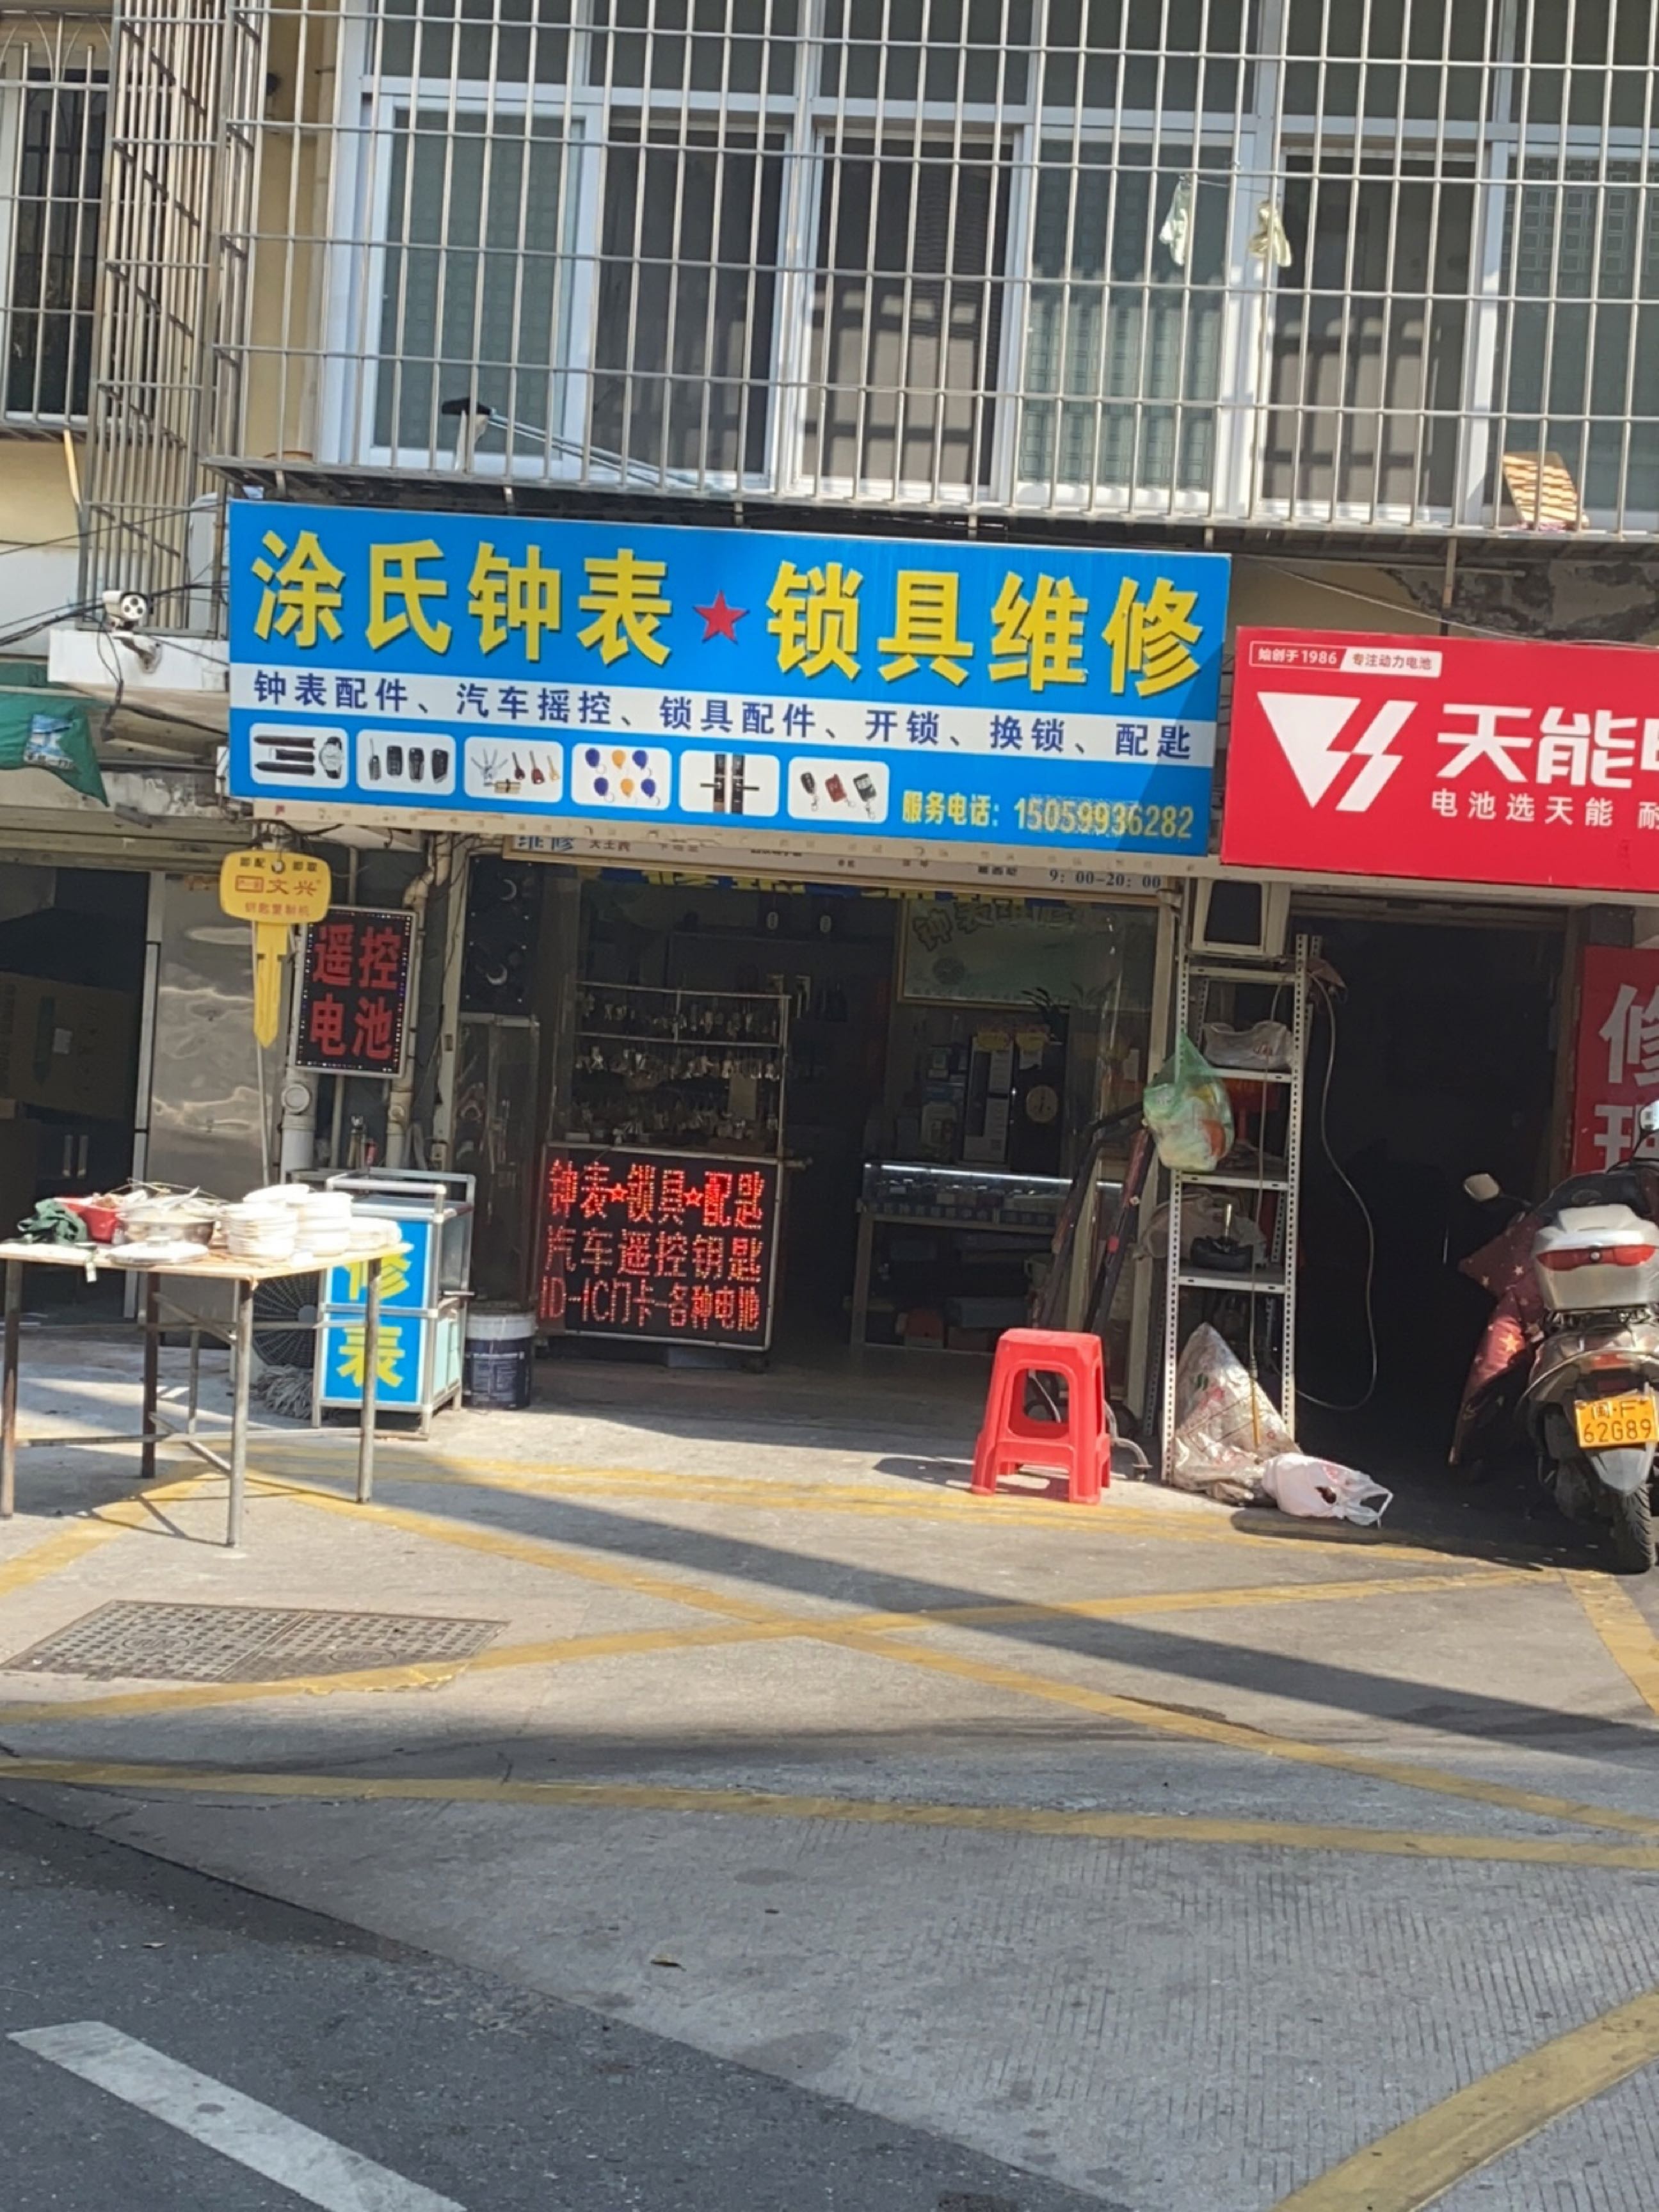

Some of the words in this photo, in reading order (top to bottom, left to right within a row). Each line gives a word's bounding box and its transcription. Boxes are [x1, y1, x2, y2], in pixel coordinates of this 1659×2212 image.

[250, 530, 672, 666] 涂氏钟表
[767, 561, 1203, 697] 锁具维修
[1352, 652, 1432, 671] 专注动力电池
[1436, 703, 1659, 789] 天能
[1014, 796, 1194, 838] 15059936282
[1431, 788, 1613, 828] 电池选天能
[312, 924, 401, 990] 遥控
[309, 993, 394, 1060] 电池
[545, 1225, 764, 1282] 汽车遥控钥匙
[1583, 1418, 1651, 1443] 62G89
